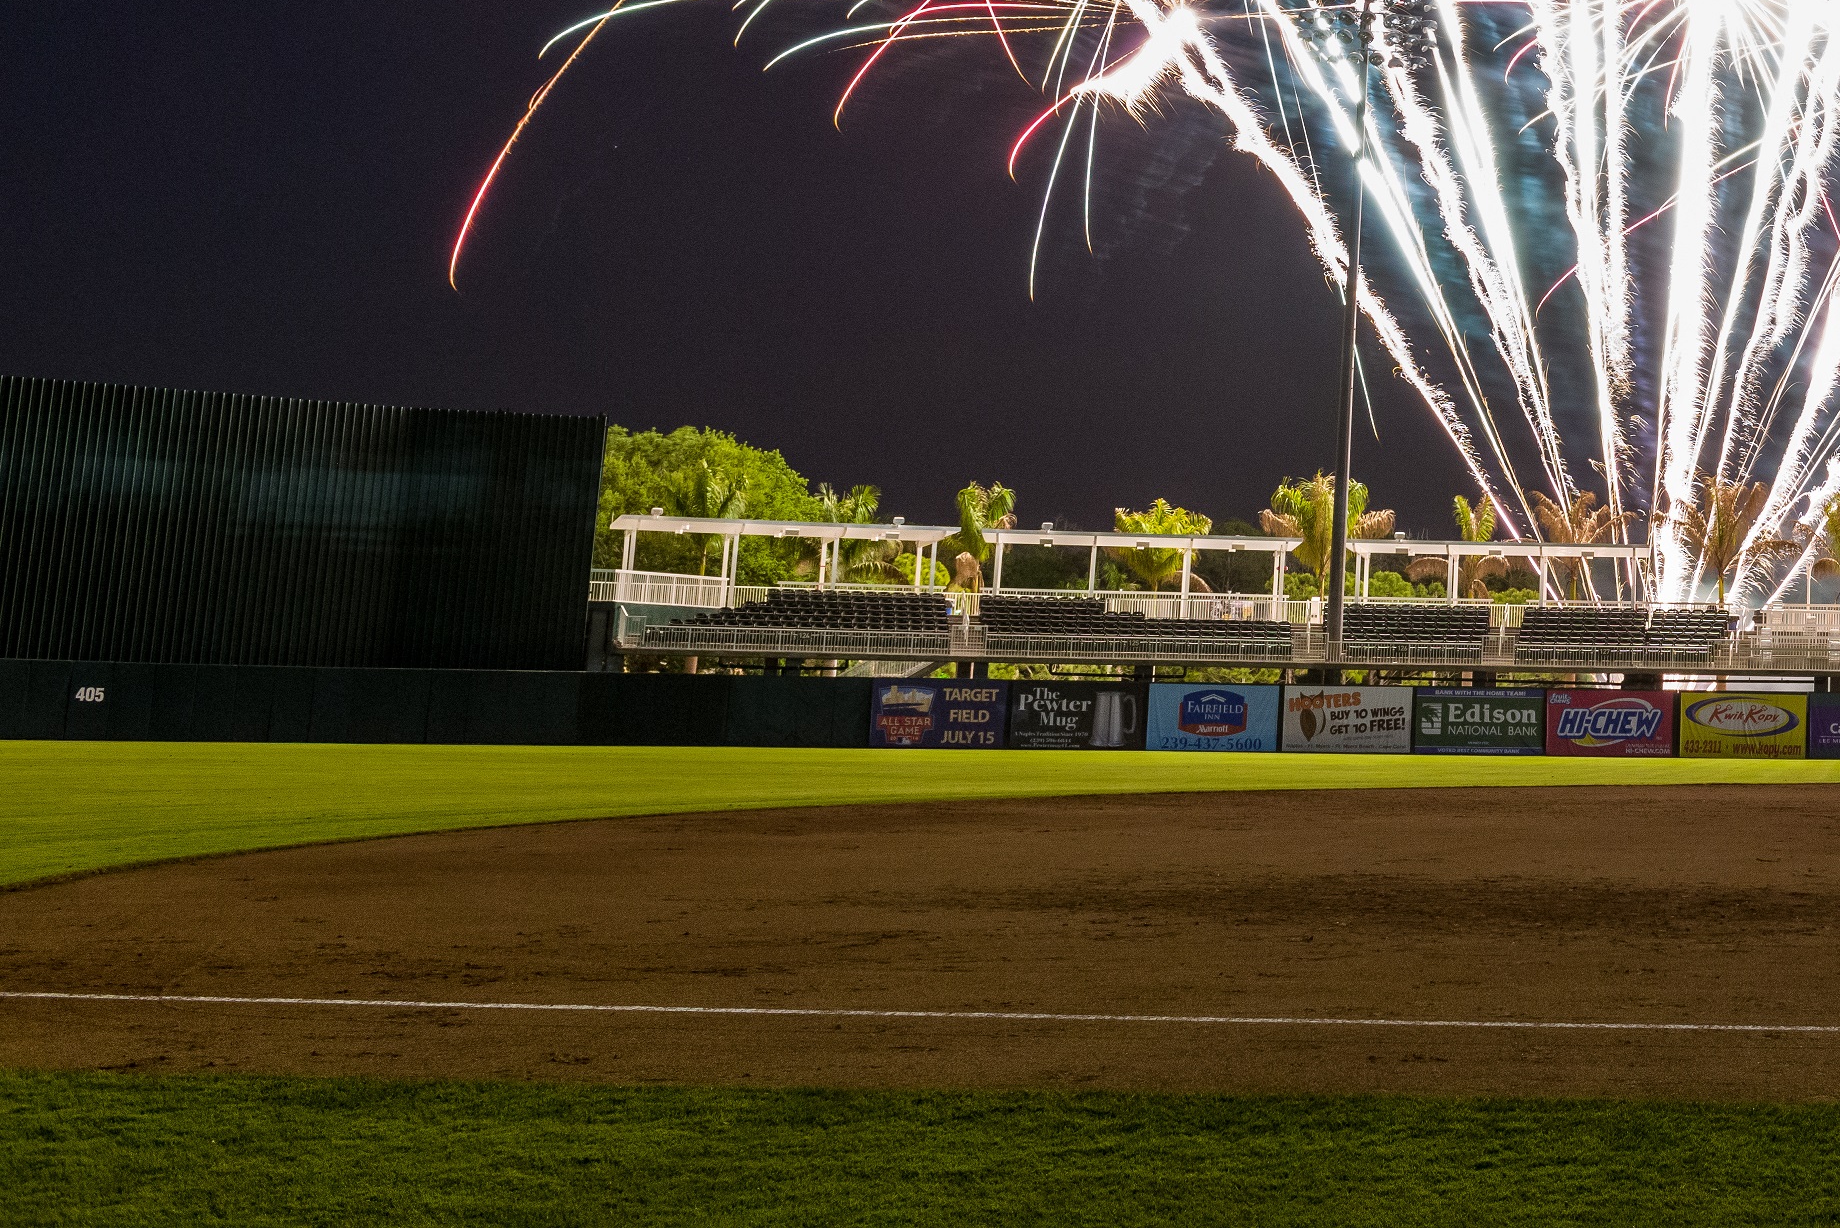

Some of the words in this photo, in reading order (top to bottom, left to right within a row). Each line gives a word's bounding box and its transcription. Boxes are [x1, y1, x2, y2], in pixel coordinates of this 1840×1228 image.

[75, 686, 105, 703] 405
[943, 687, 1000, 702] TARGET
[1033, 687, 1060, 700] The
[1018, 694, 1092, 712] Pewter
[1187, 701, 1244, 714] FAIRFIELD
[1288, 691, 1362, 713] HOOTERS
[949, 709, 990, 723] FIELD
[1039, 711, 1079, 731] Mug
[1330, 710, 1351, 721] BUY
[1353, 708, 1369, 719] 10
[1370, 706, 1405, 718] WINGS
[1447, 703, 1538, 724] Edison
[1707, 704, 1744, 725] Kwik
[1743, 704, 1779, 725] Kopy
[880, 717, 900, 726] ALL
[904, 717, 931, 726] STAR
[1196, 724, 1229, 734] Marriott
[1329, 724, 1349, 735] GET
[1353, 723, 1368, 734] 10
[1369, 717, 1406, 732] FREE!
[1557, 708, 1664, 739] HI-CHEW
[890, 726, 920, 735] GAME
[940, 730, 976, 744] JULY
[978, 731, 995, 745] 15
[1447, 725, 1503, 736] NATIONAL
[1507, 726, 1537, 736] BANK
[1161, 736, 1262, 750] 239-437-5600
[1684, 739, 1722, 754] 433-2311
[1732, 742, 1802, 758] www.kopy.com
